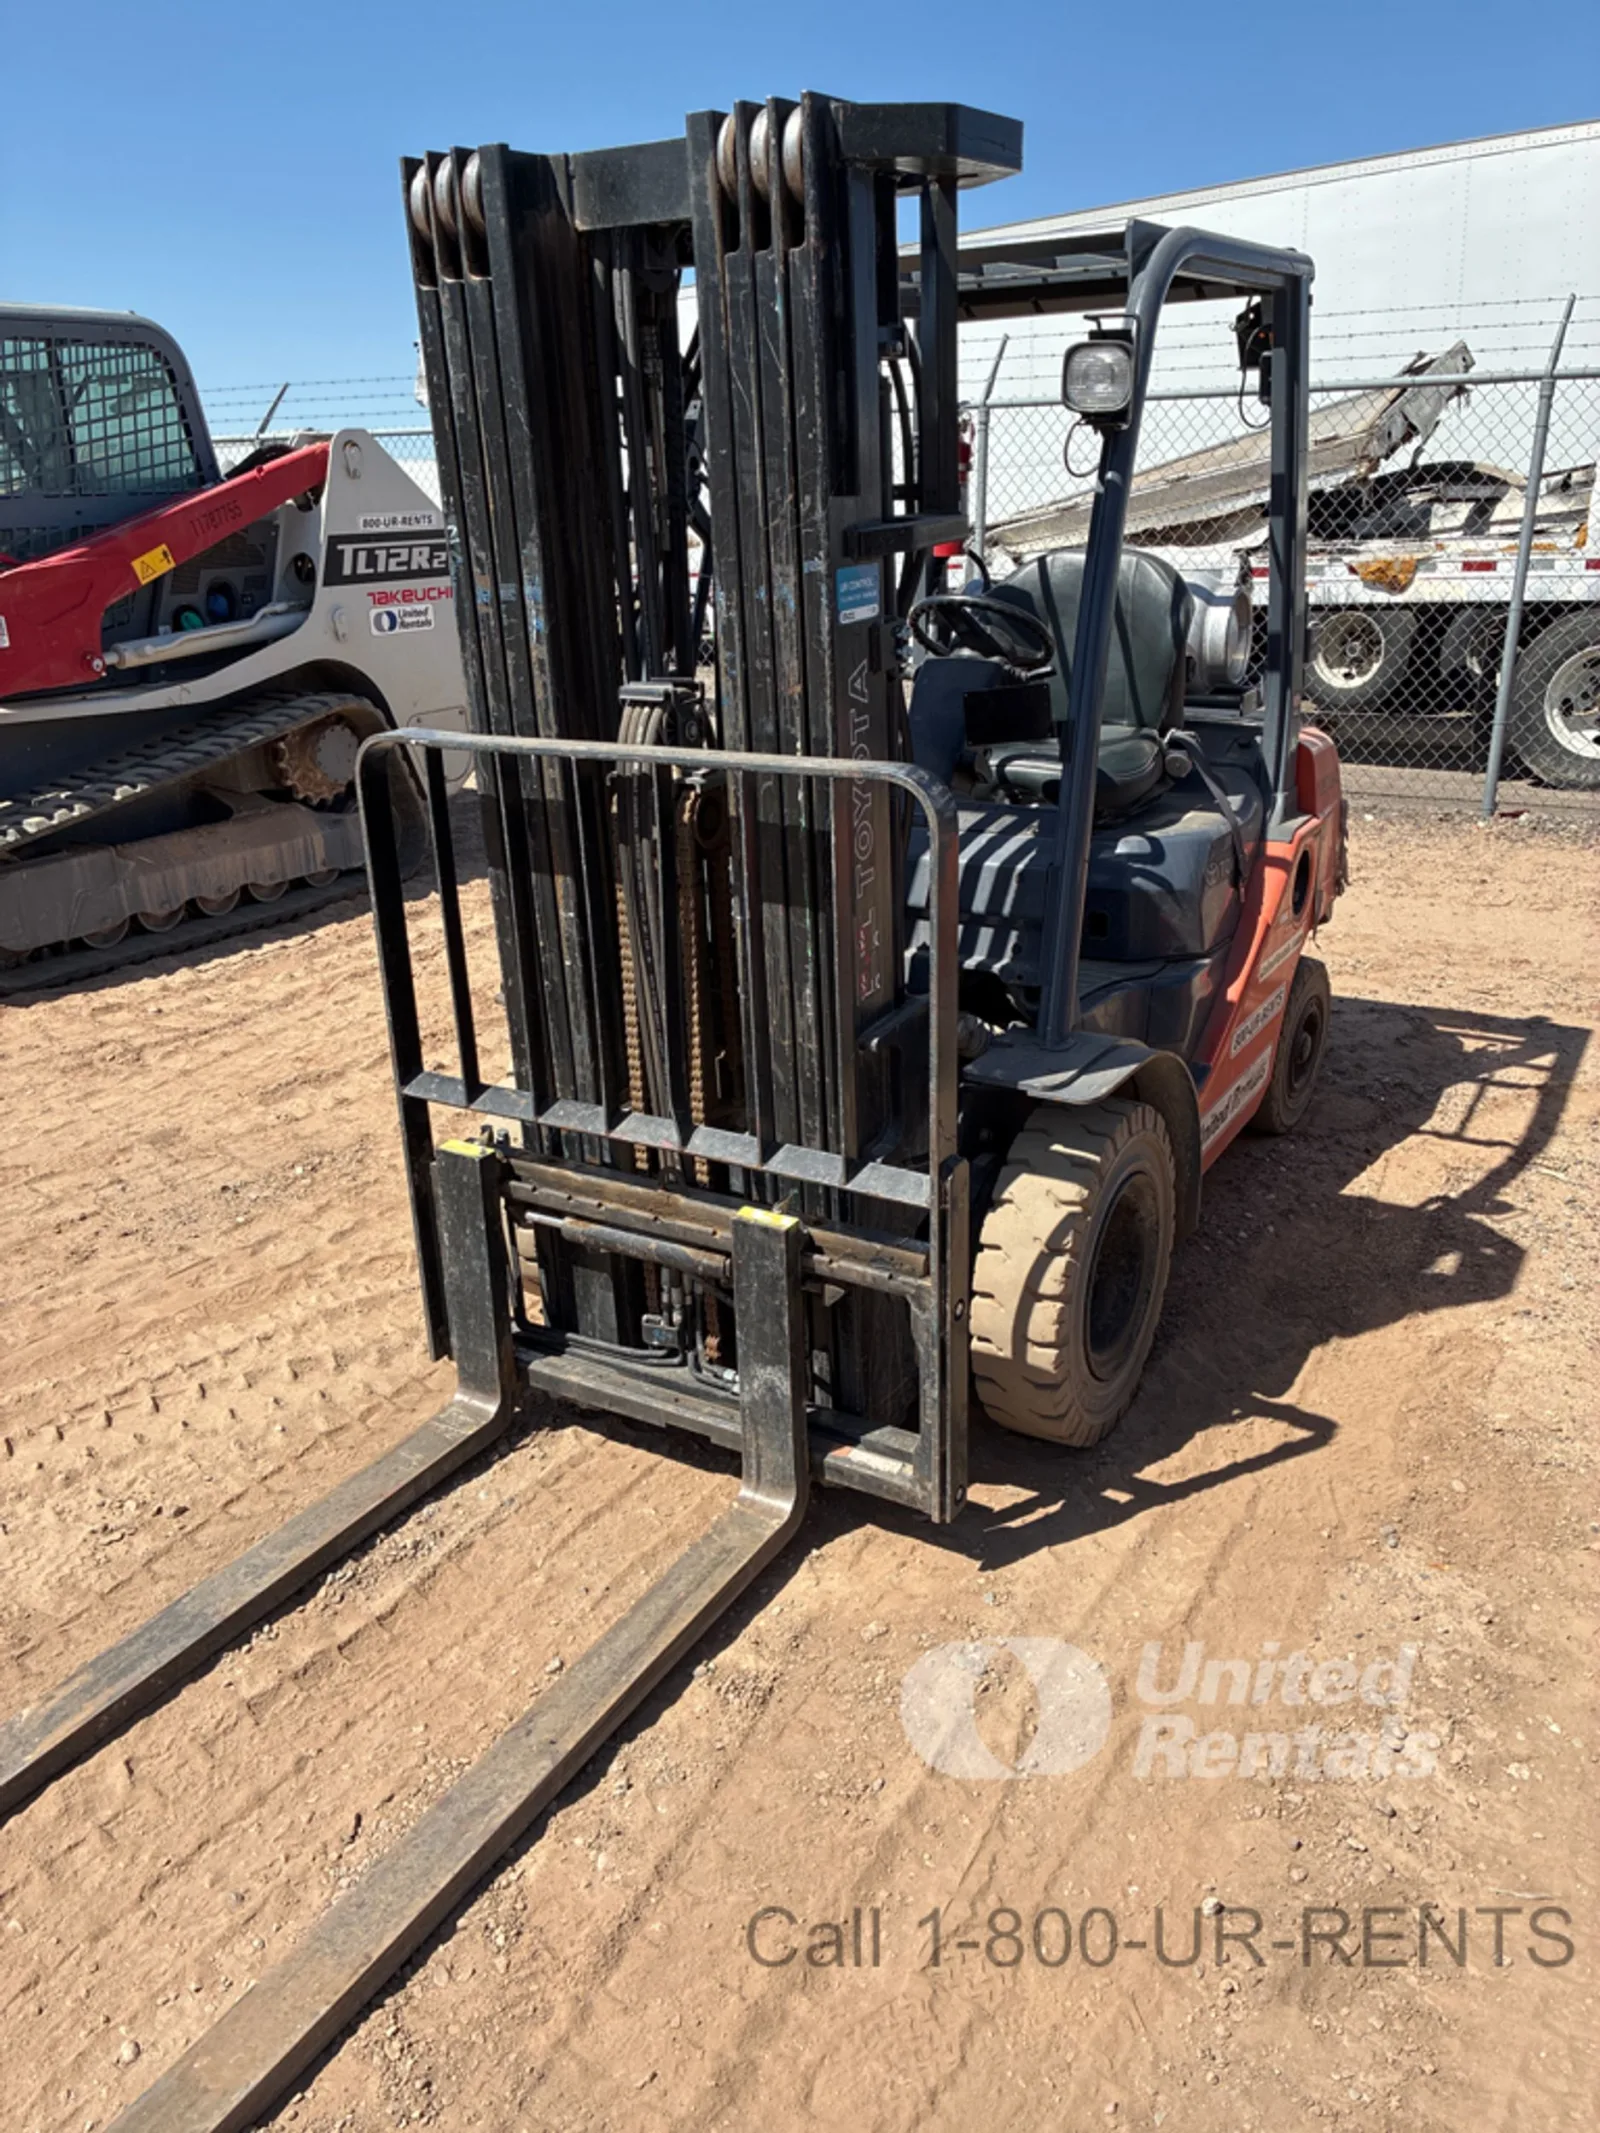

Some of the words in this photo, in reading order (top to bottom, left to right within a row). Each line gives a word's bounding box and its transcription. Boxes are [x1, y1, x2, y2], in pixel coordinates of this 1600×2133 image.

[362, 514, 433, 529] 800-UR-RENTS
[366, 586, 454, 606] TAKEUCHI
[398, 606, 429, 620] United
[399, 618, 432, 630] Rentals
